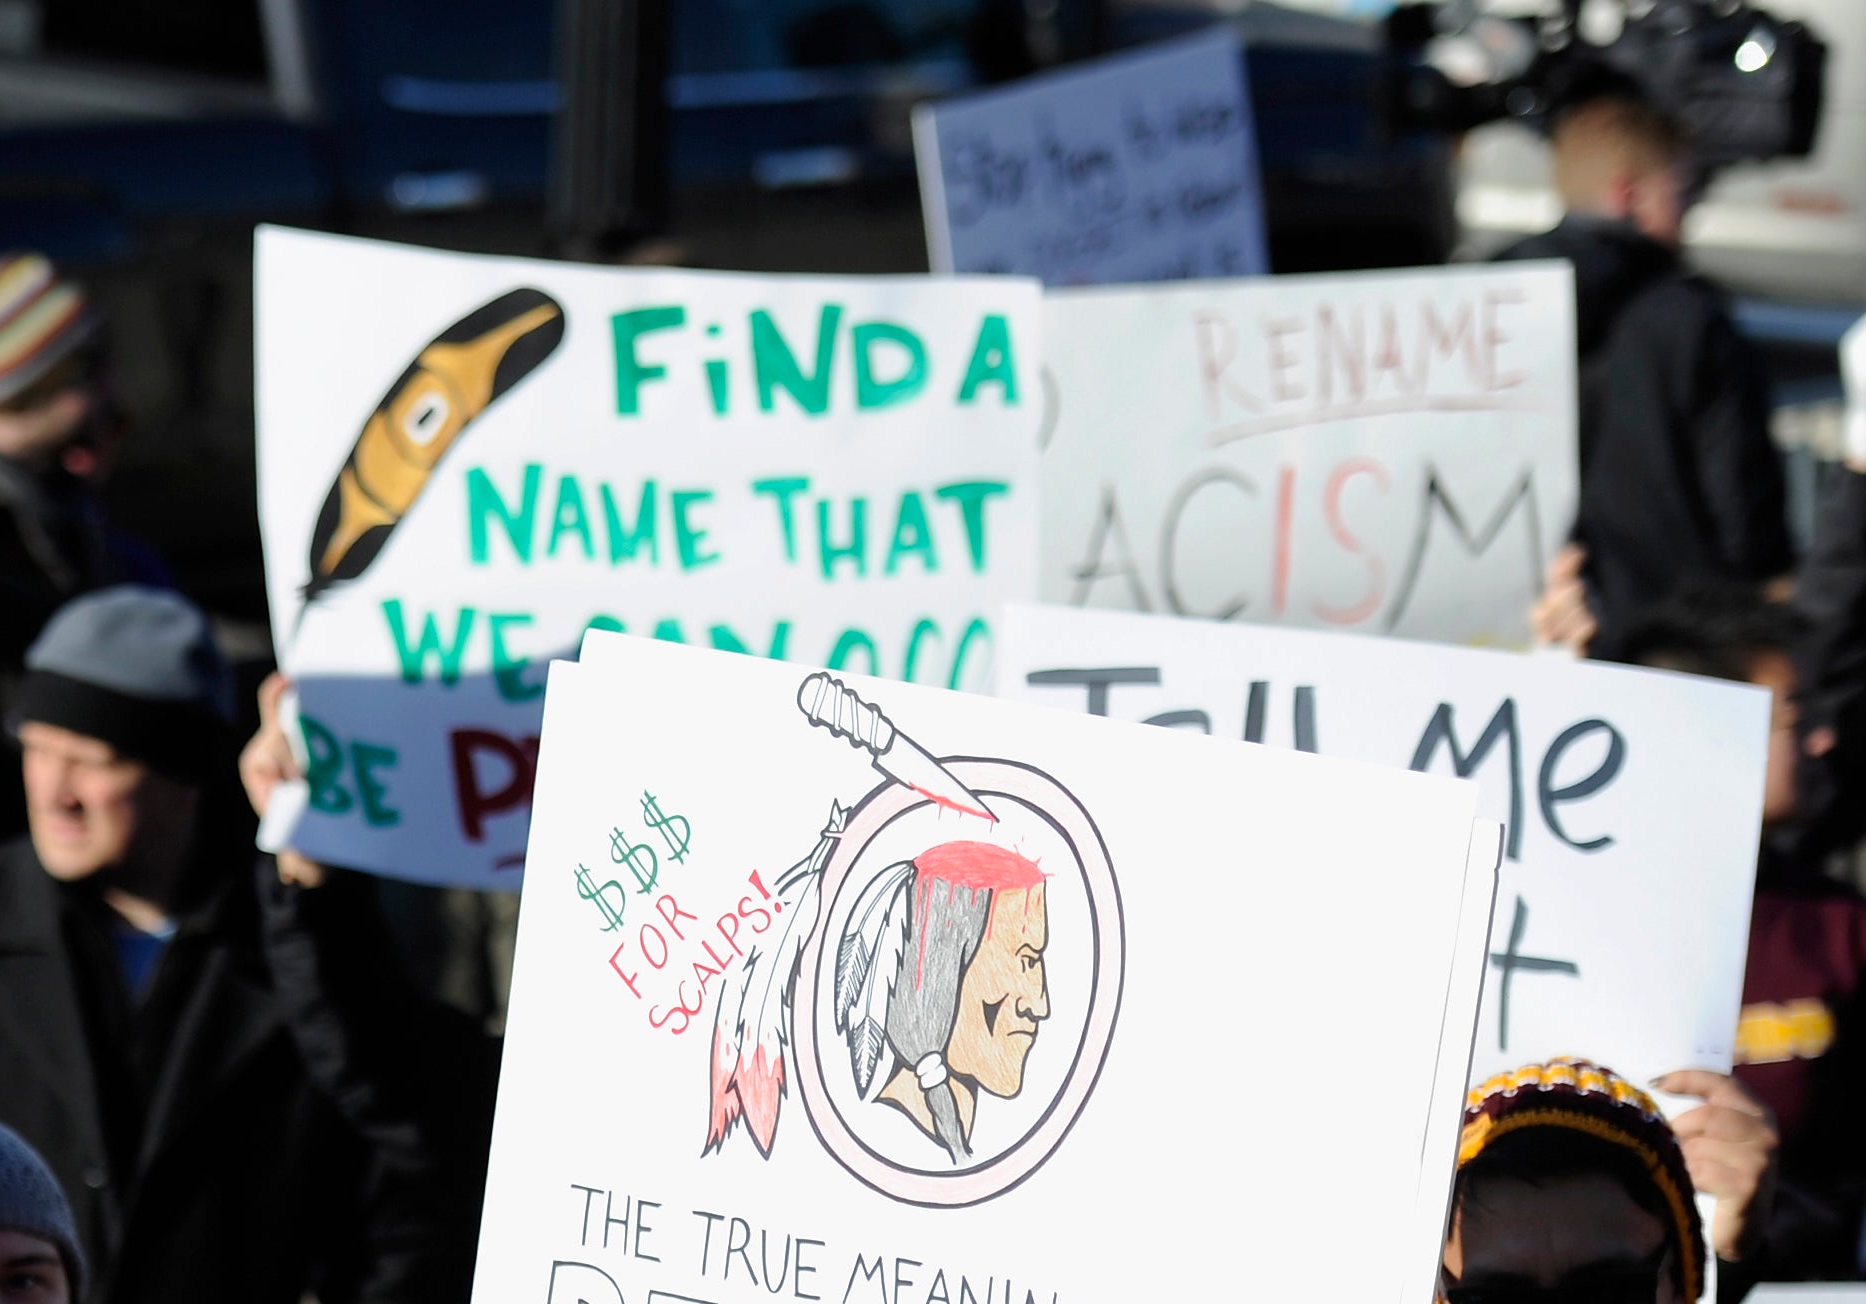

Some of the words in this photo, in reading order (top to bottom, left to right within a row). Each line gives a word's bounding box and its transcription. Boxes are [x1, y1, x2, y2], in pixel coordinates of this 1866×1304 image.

[956, 314, 1021, 412] A
[1194, 287, 1528, 421] RENAME
[464, 462, 720, 571] NAME
[751, 476, 1013, 580] THAT
[1070, 451, 1546, 633] ACISM
[381, 597, 545, 702] WE
[608, 893, 699, 1000] FOR
[647, 869, 788, 1037] SCALPS!
[571, 1183, 663, 1262] THE
[693, 1210, 826, 1300] TRUE
